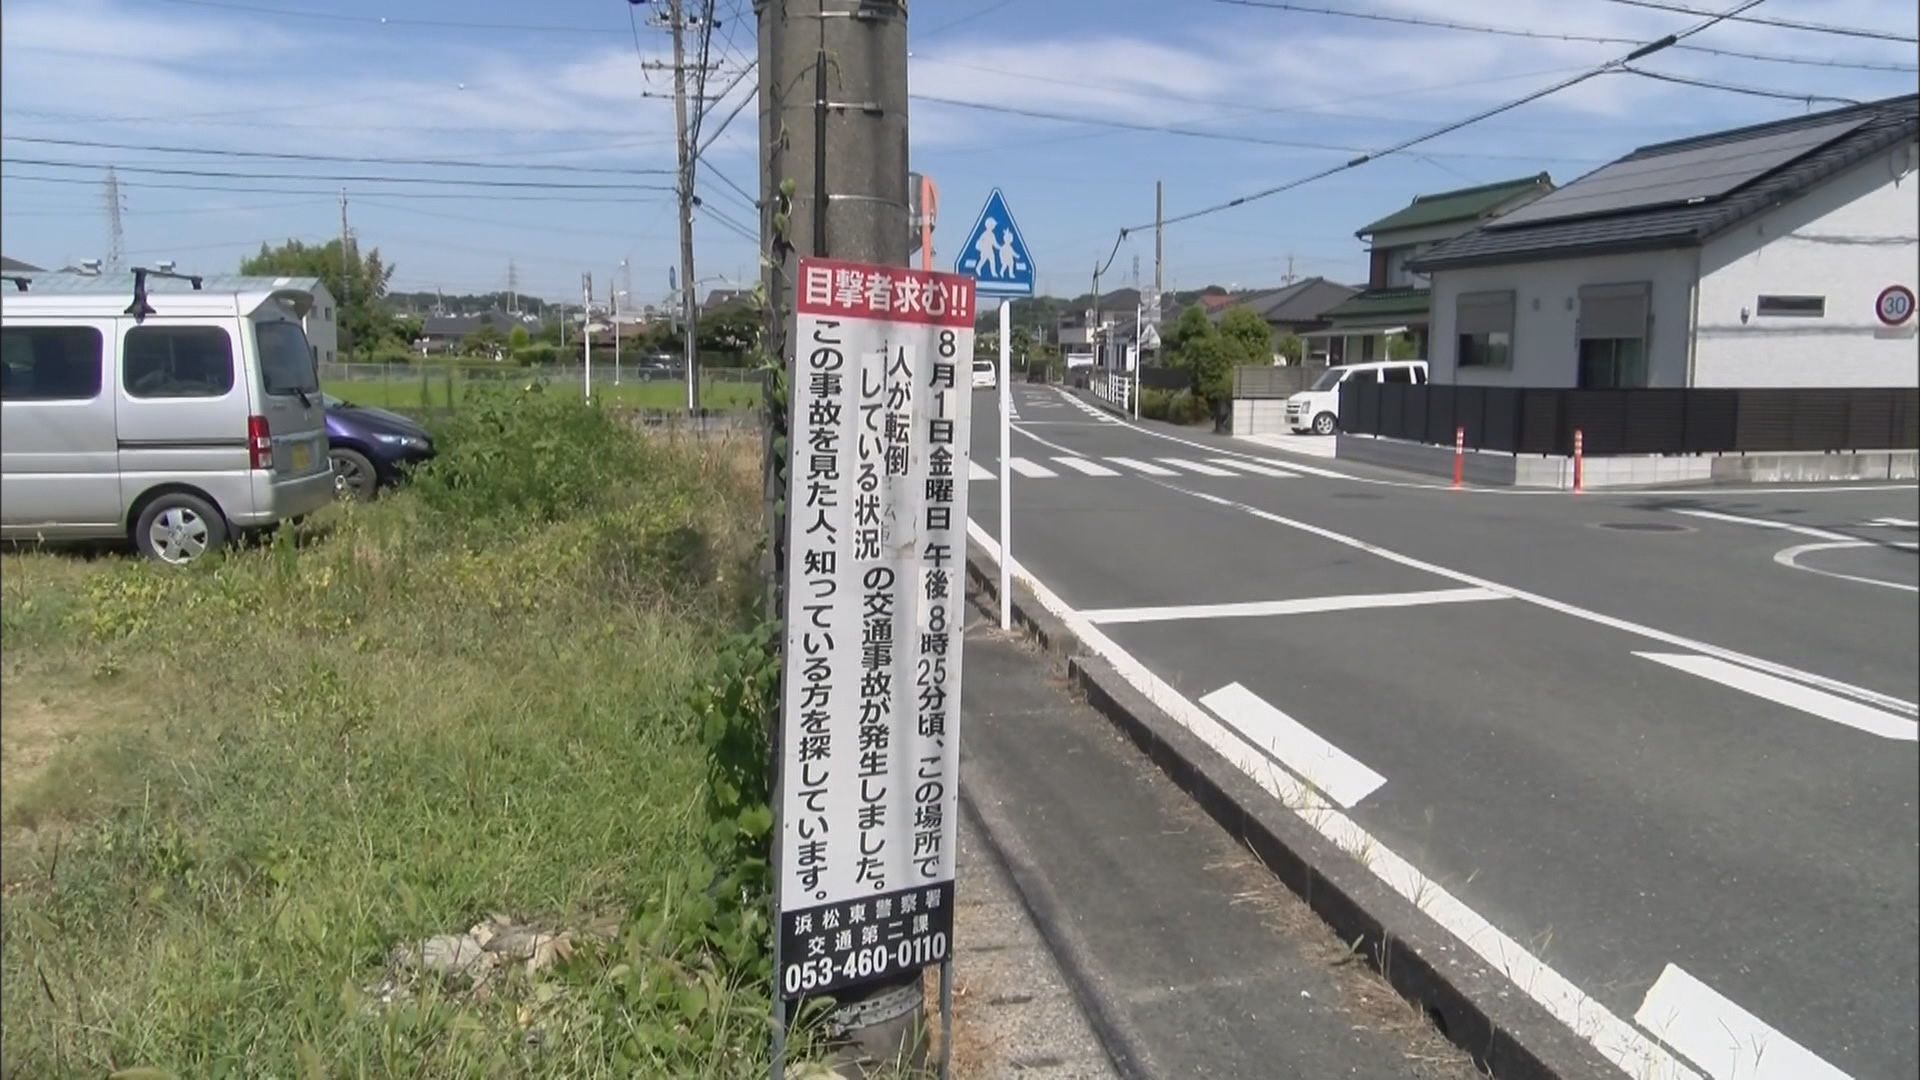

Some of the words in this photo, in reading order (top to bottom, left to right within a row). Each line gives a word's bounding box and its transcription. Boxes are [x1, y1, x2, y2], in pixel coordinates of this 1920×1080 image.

[806, 266, 967, 317] 目撃者求む!!
[1884, 297, 1906, 314] 30
[794, 889, 941, 936] 浜松東警察署
[807, 913, 929, 957] 交通第二課
[785, 932, 946, 993] 053-460-0110
